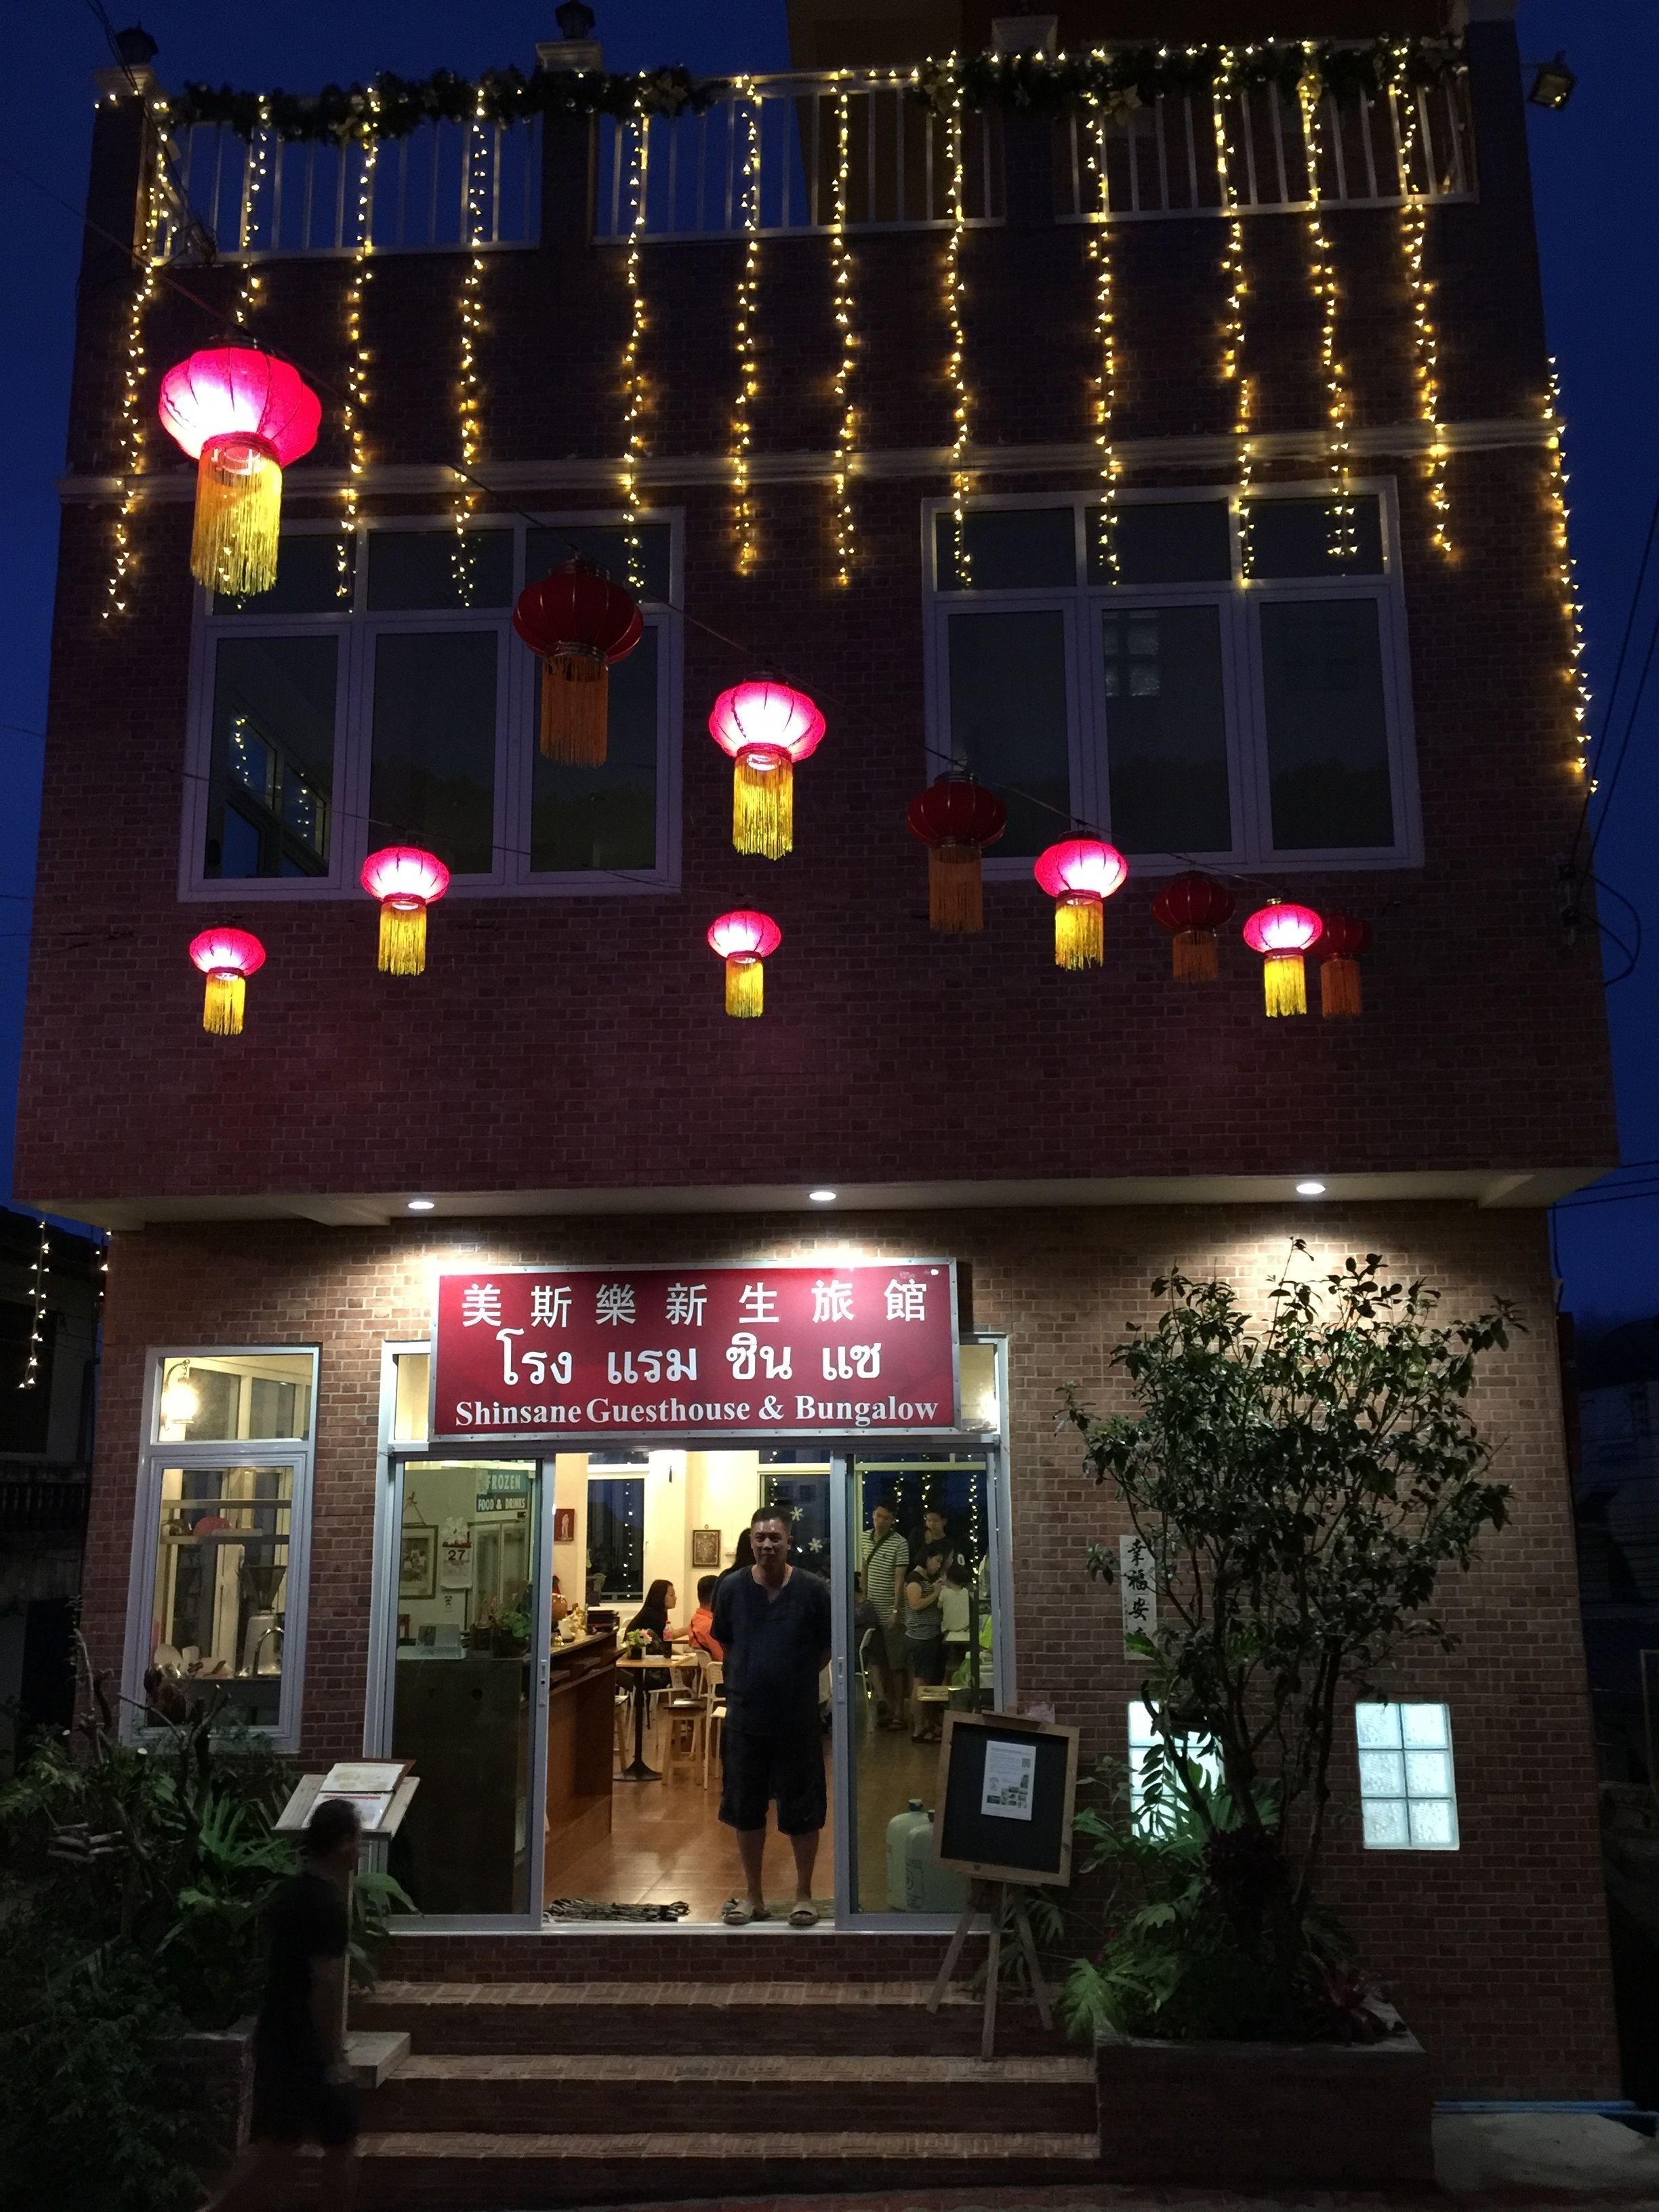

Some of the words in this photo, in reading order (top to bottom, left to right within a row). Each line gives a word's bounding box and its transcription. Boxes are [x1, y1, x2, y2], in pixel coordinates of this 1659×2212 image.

[462, 1279, 927, 1328] 美斯樂新生旅館
[496, 1328, 572, 1385] โรง
[609, 1348, 697, 1385] แรม
[823, 1343, 882, 1381] แซ
[456, 1401, 581, 1426] Shinsane
[587, 1395, 750, 1423] Guesthouse
[758, 1395, 785, 1420] &
[795, 1395, 939, 1427] Bungalow
[487, 1474, 520, 1490] FROZEN
[478, 1498, 494, 1511] FOOD
[496, 1498, 502, 1510] &
[505, 1498, 525, 1510] DRINKS
[448, 1549, 466, 1561] 27
